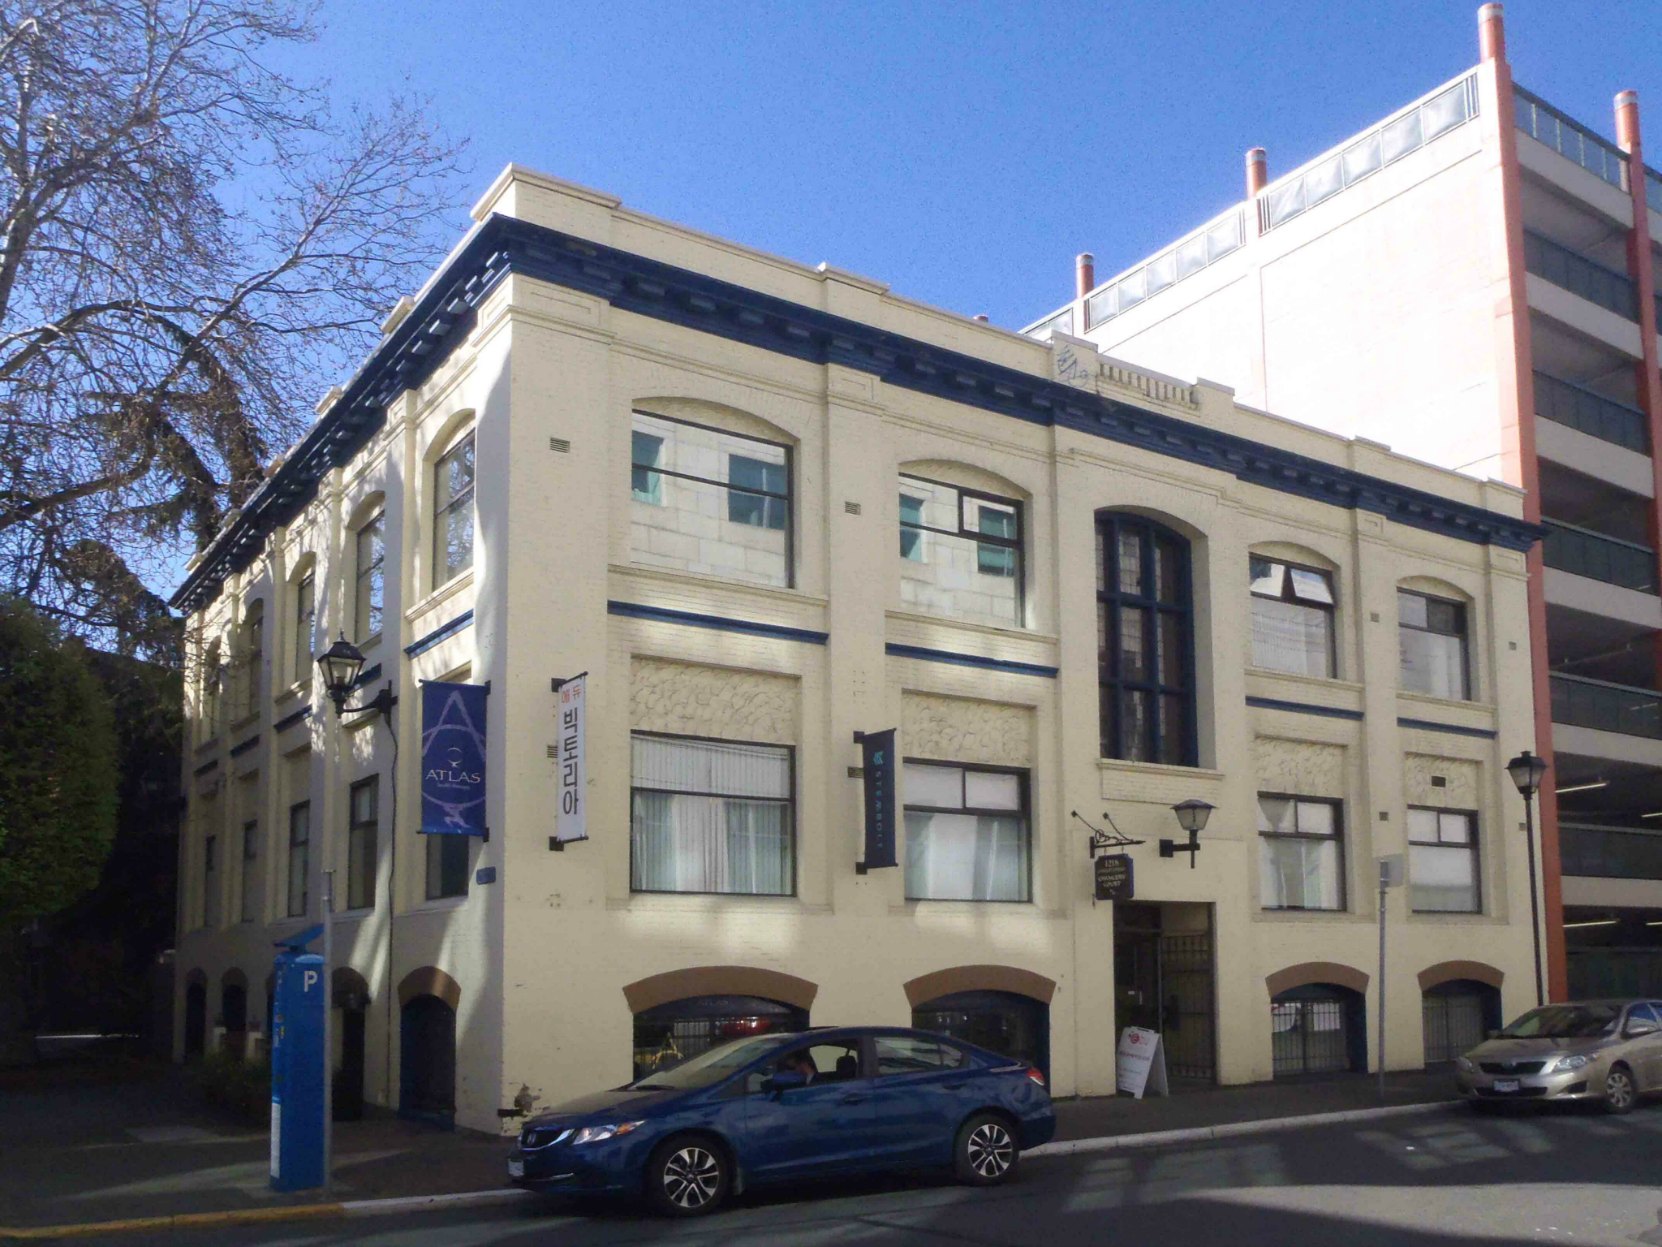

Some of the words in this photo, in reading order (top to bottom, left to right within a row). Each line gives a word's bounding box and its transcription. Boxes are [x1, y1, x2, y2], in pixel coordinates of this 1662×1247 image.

[563, 707, 579, 815] 빅토리아
[425, 769, 481, 784] ATLAS
[304, 970, 318, 992] P
